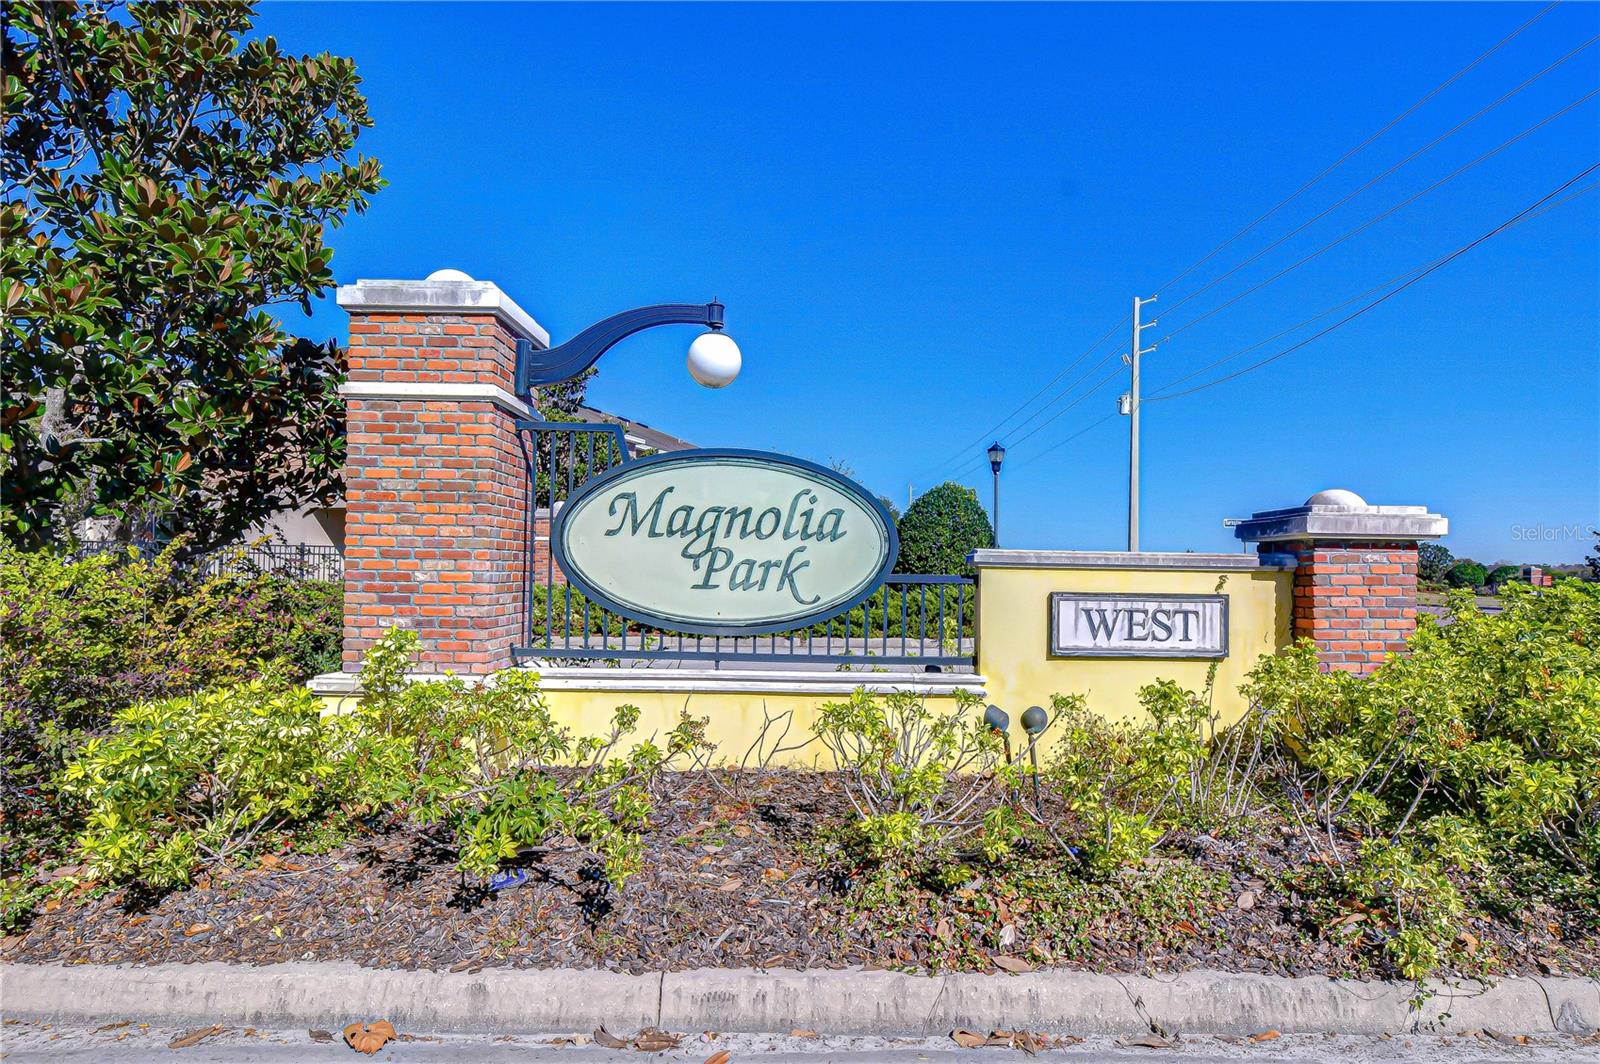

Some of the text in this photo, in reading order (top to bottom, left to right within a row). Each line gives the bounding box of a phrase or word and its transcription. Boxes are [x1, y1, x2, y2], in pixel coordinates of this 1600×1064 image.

[604, 486, 847, 571] Magnolia
[691, 546, 821, 605] Park
[1080, 607, 1200, 642] WEST
